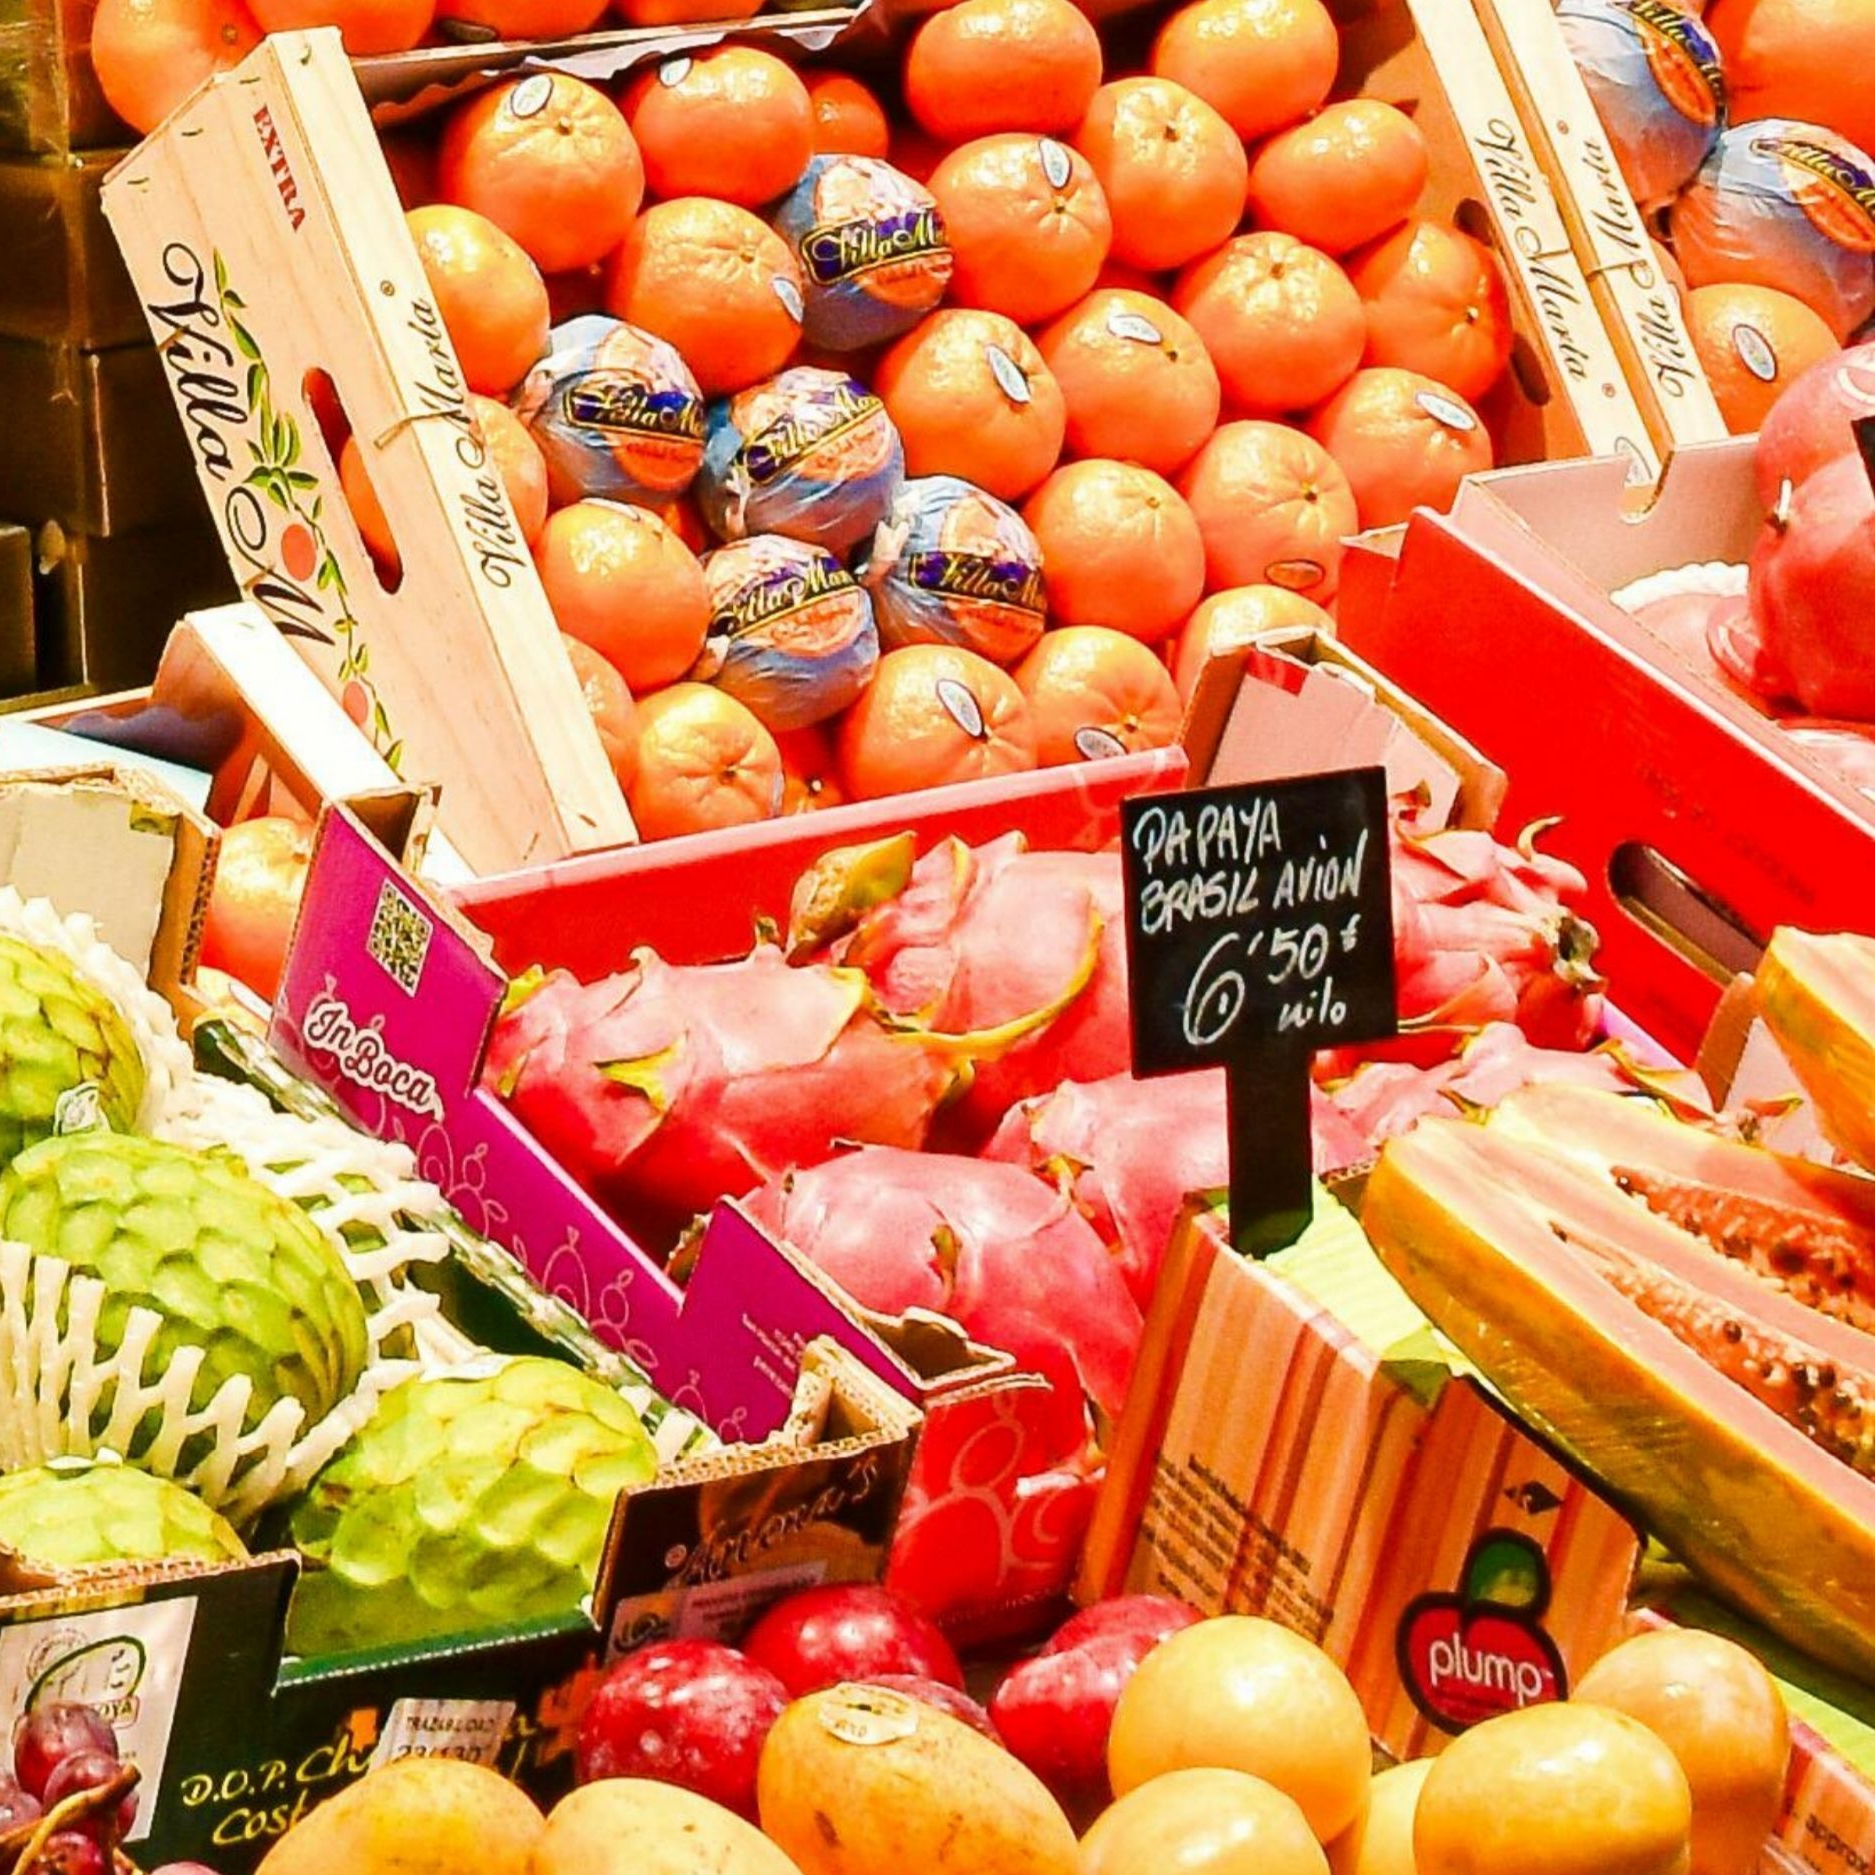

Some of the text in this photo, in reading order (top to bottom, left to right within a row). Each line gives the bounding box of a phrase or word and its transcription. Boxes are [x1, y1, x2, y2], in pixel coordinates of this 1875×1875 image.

[253, 104, 305, 233] EXTRA
[1475, 118, 1536, 221] Villa
[147, 243, 248, 482] Villa
[1637, 299, 1695, 398] Villa
[457, 477, 527, 588] Villa
[1133, 797, 1282, 875] PAPAYA
[1140, 866, 1259, 934] BRASIL
[1428, 1633, 1543, 1707] plump
[181, 1760, 286, 1806] D.O.P.
